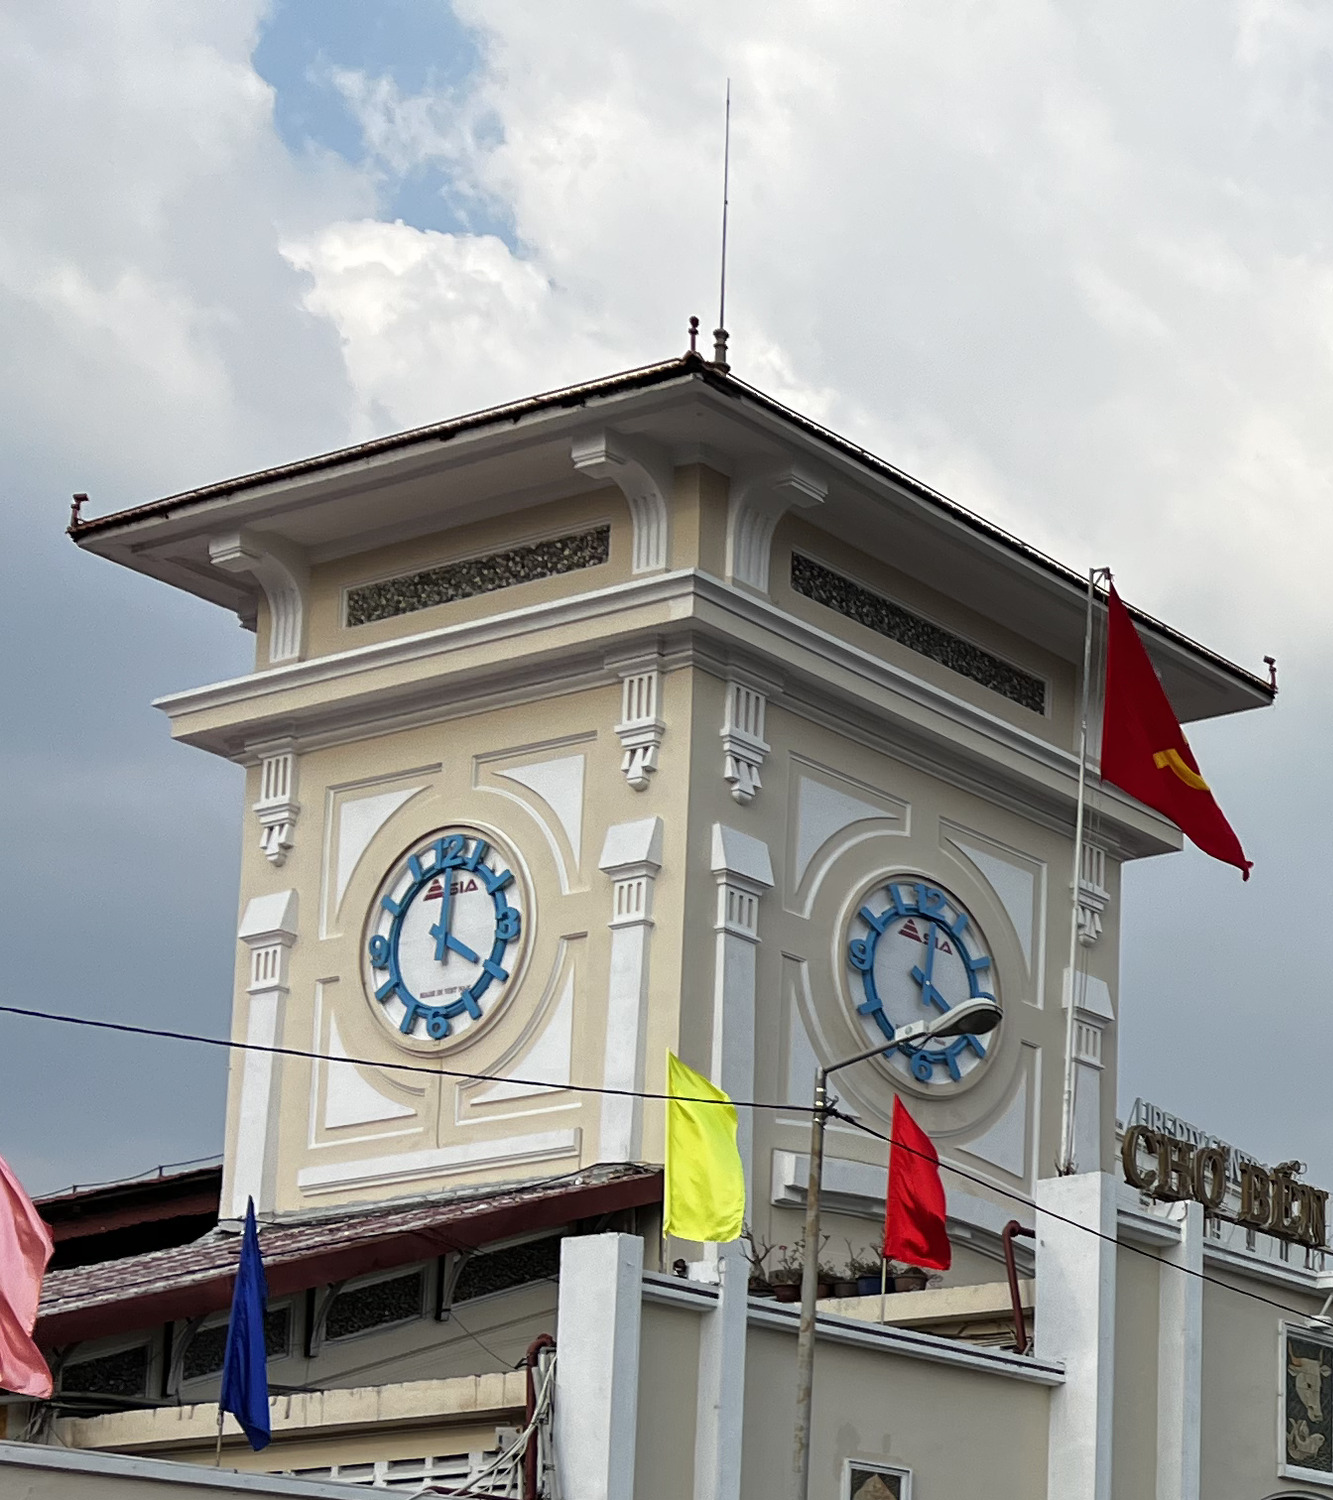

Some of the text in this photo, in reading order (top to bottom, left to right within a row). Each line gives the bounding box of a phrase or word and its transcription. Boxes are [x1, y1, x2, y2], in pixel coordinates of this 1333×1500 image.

[432, 834, 465, 869] 12
[914, 883, 946, 922] 12
[496, 906, 521, 941] 3
[369, 935, 389, 968] 9
[849, 938, 872, 970] 9
[427, 1007, 449, 1039] 6
[912, 1051, 933, 1083] 6
